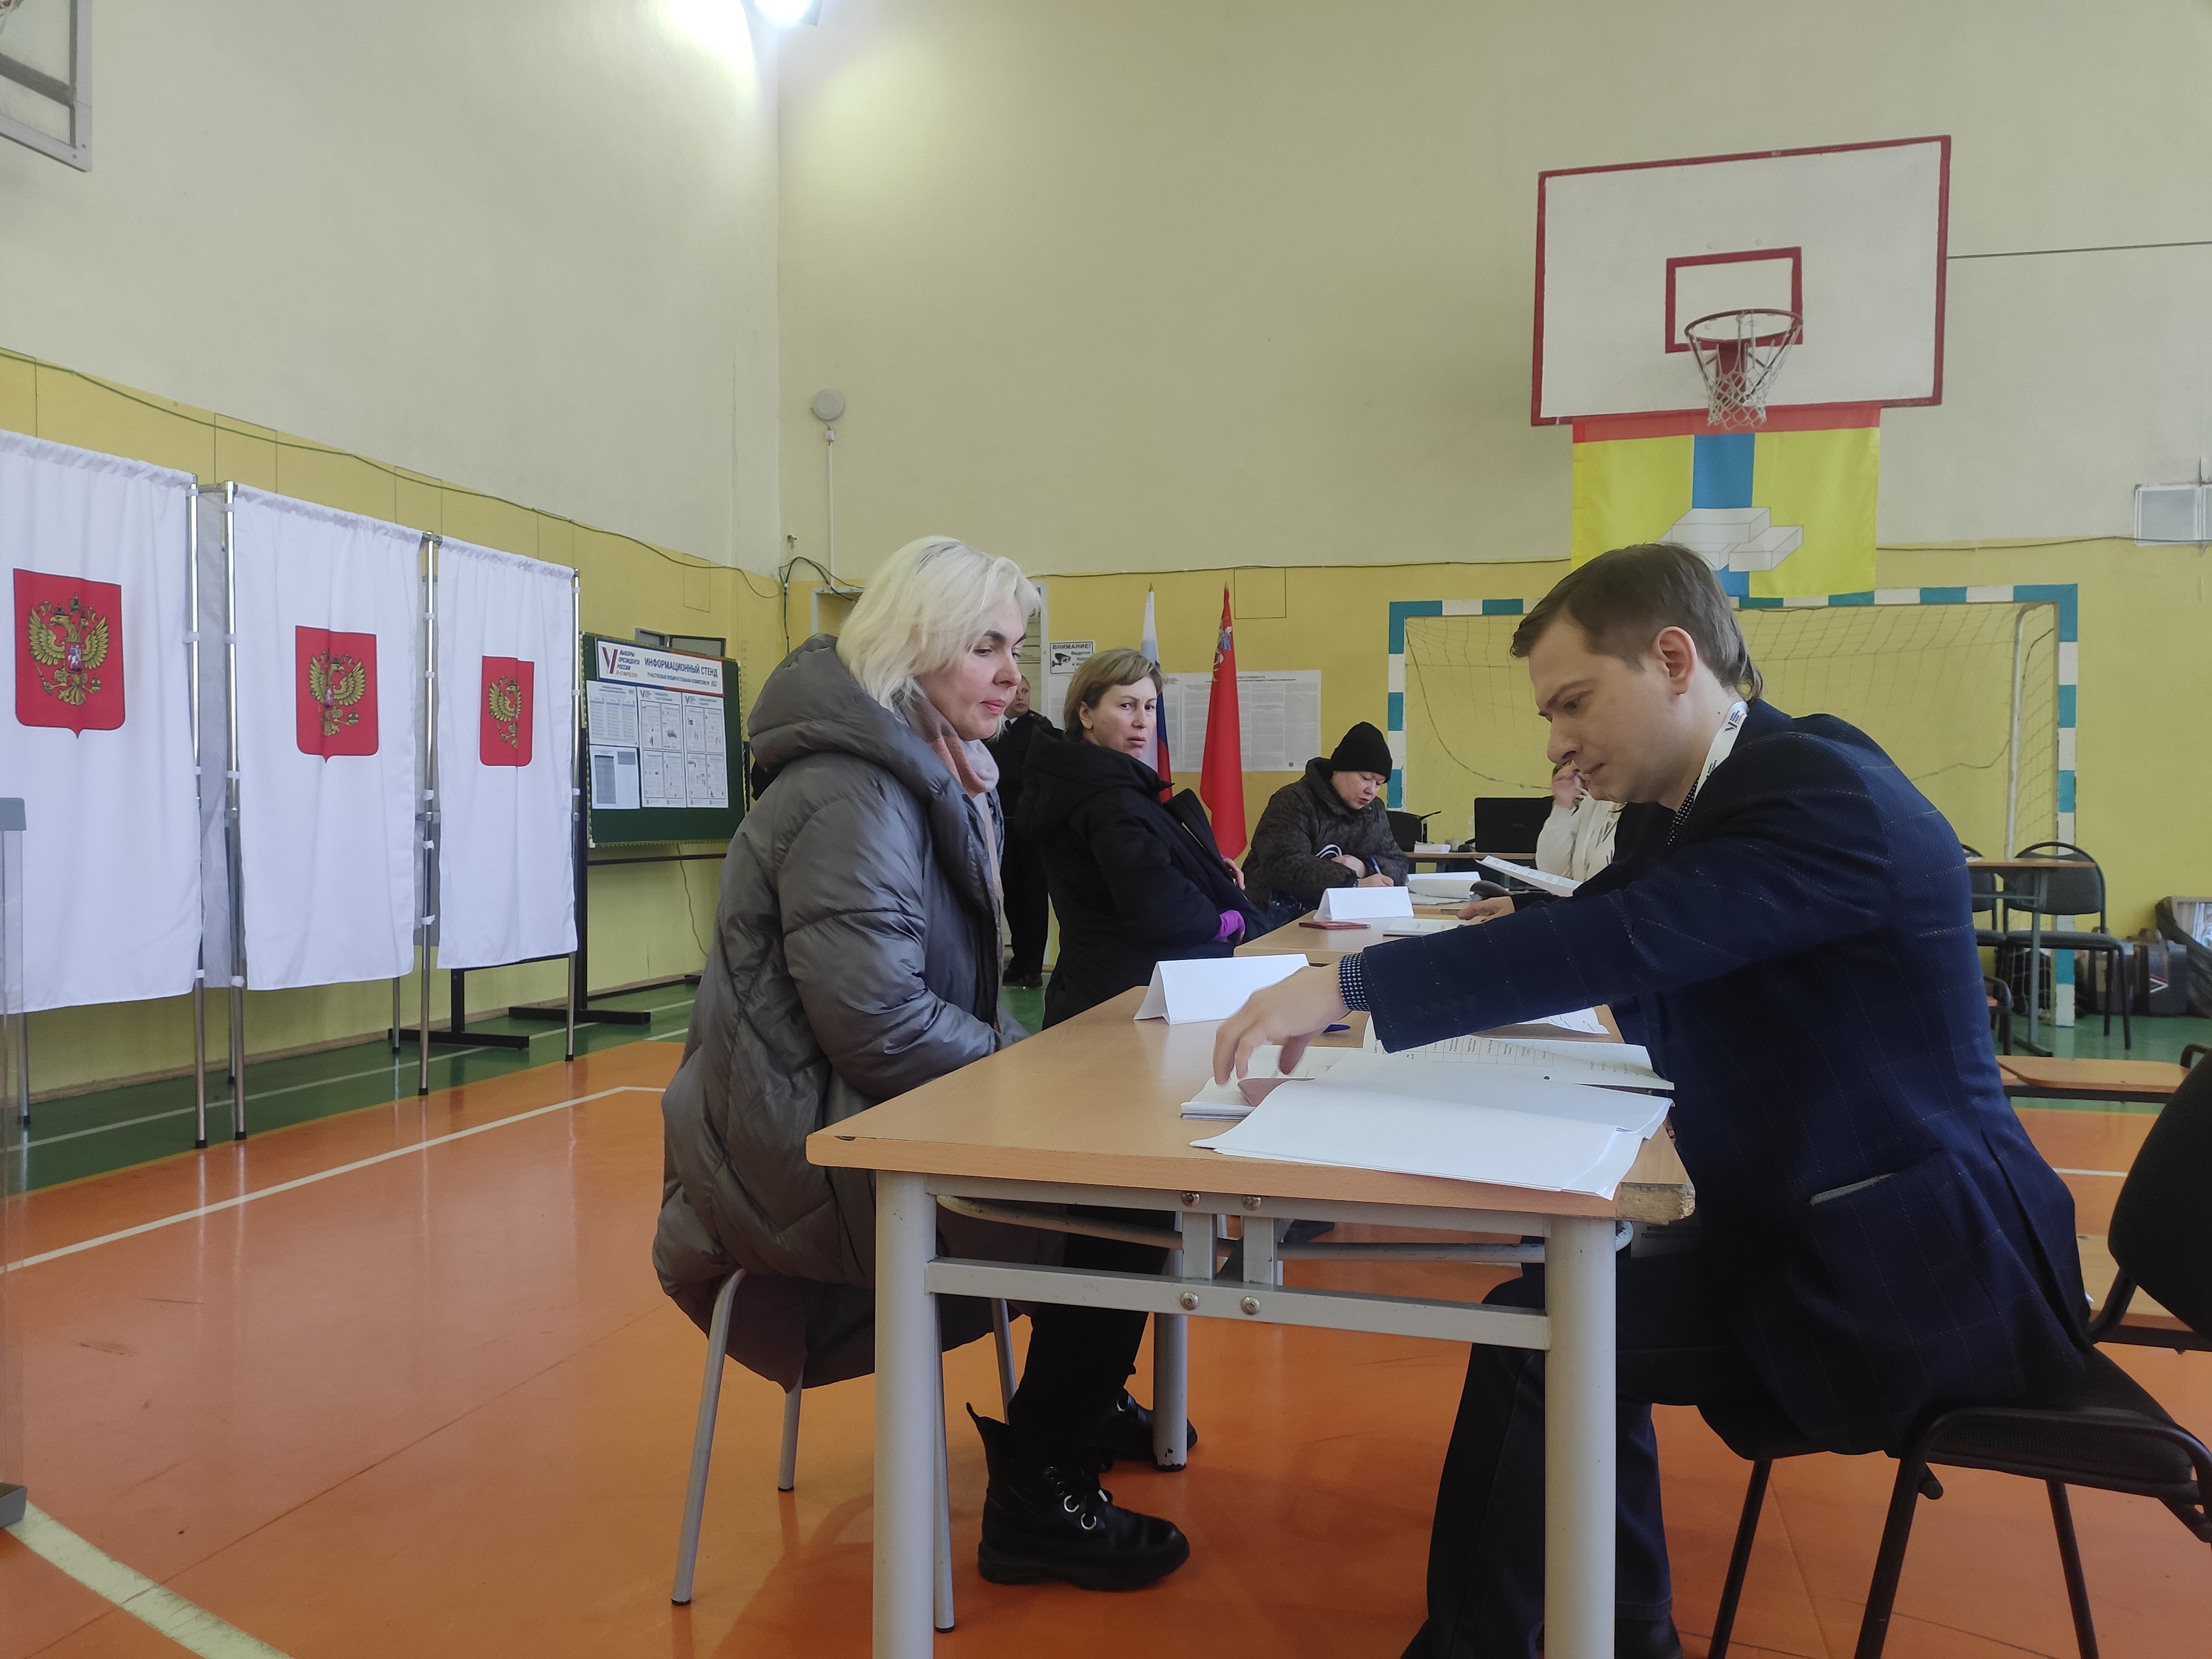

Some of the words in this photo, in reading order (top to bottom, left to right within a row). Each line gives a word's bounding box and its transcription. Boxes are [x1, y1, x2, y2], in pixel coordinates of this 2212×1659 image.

[618, 656, 640, 665] ПРЕЗИДЕНТА
[644, 656, 700, 674] ИНФОРМАЦИОННЫЙ
[701, 666, 718, 679] СТЕНД
